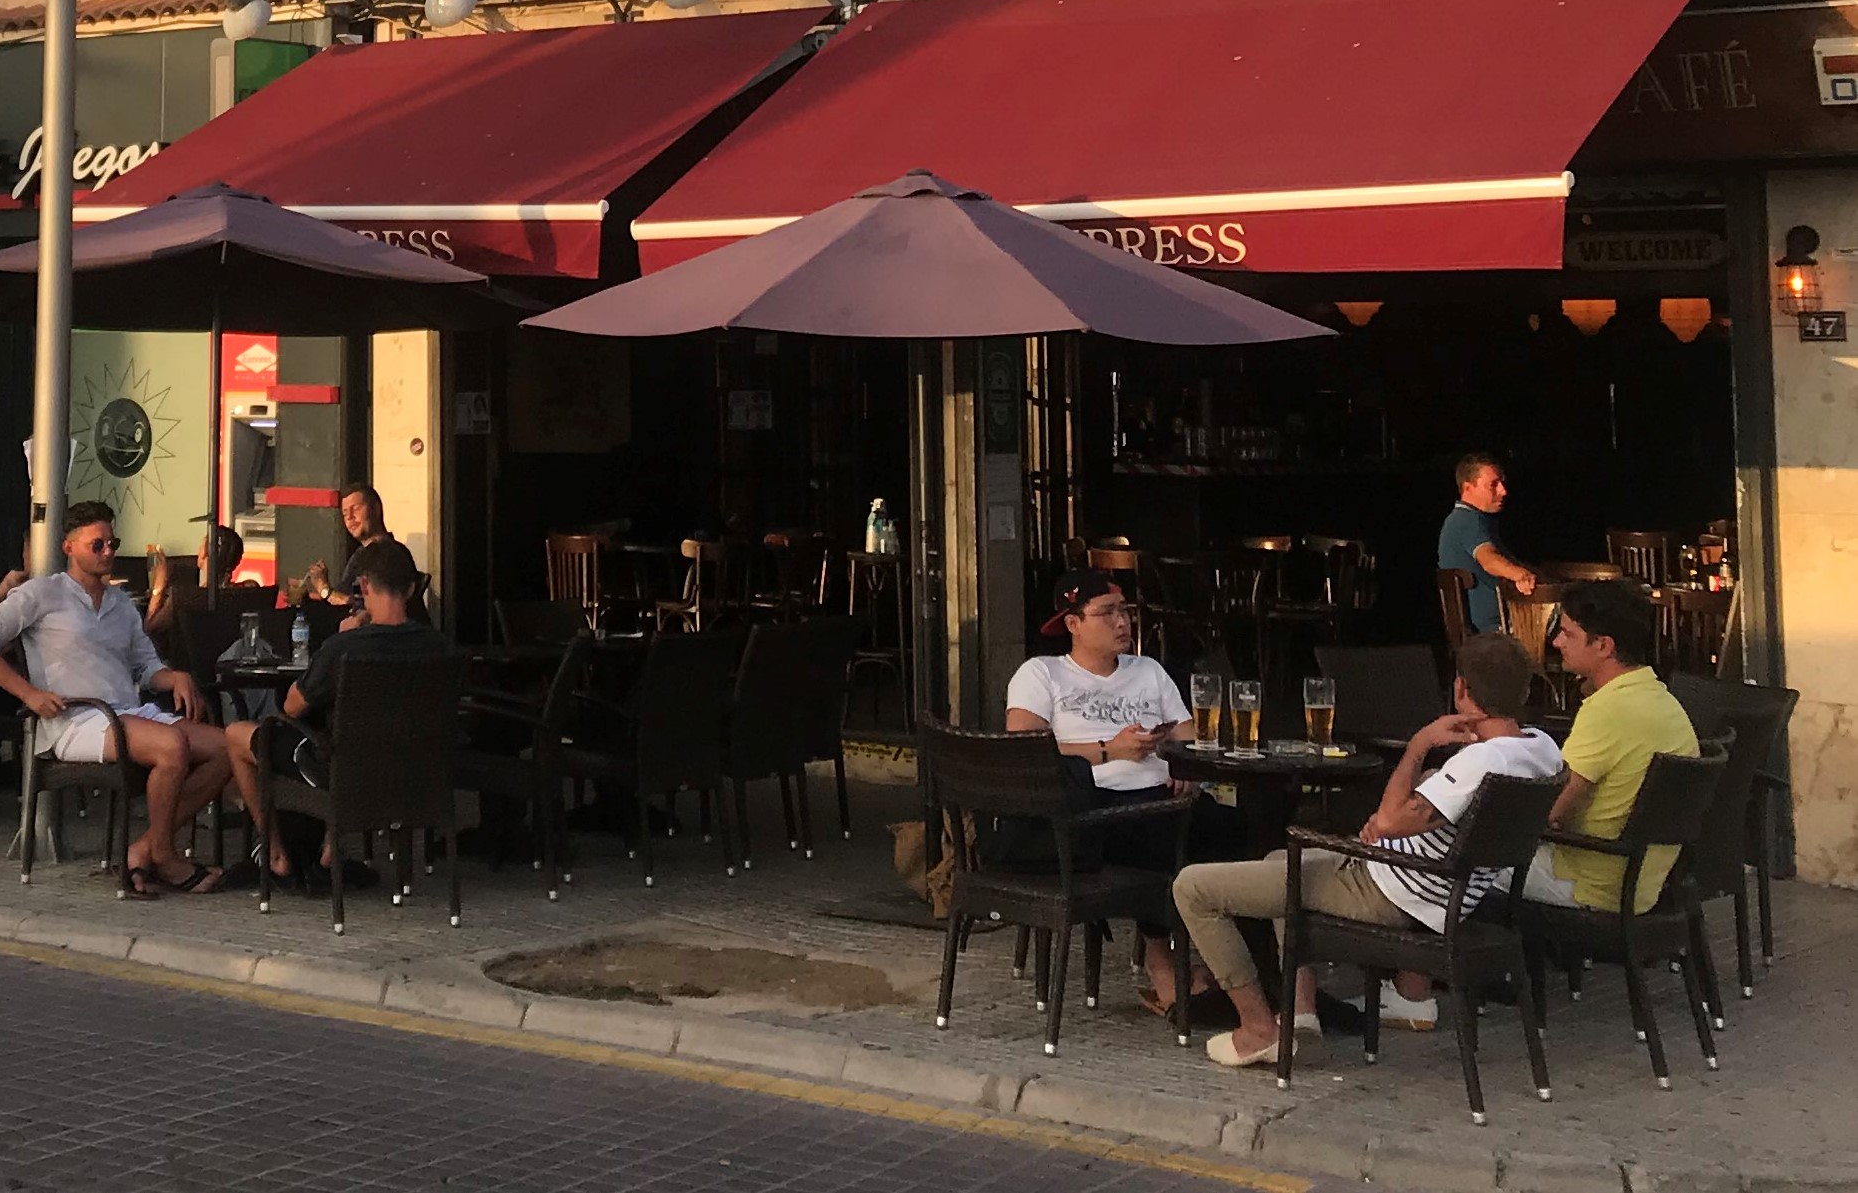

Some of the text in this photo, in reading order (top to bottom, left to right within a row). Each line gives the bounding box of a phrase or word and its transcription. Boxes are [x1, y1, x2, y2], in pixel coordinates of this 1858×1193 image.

[1073, 222, 1247, 265] PRESS
[1577, 238, 1713, 262] WELCOME
[1806, 317, 1840, 336] 47
